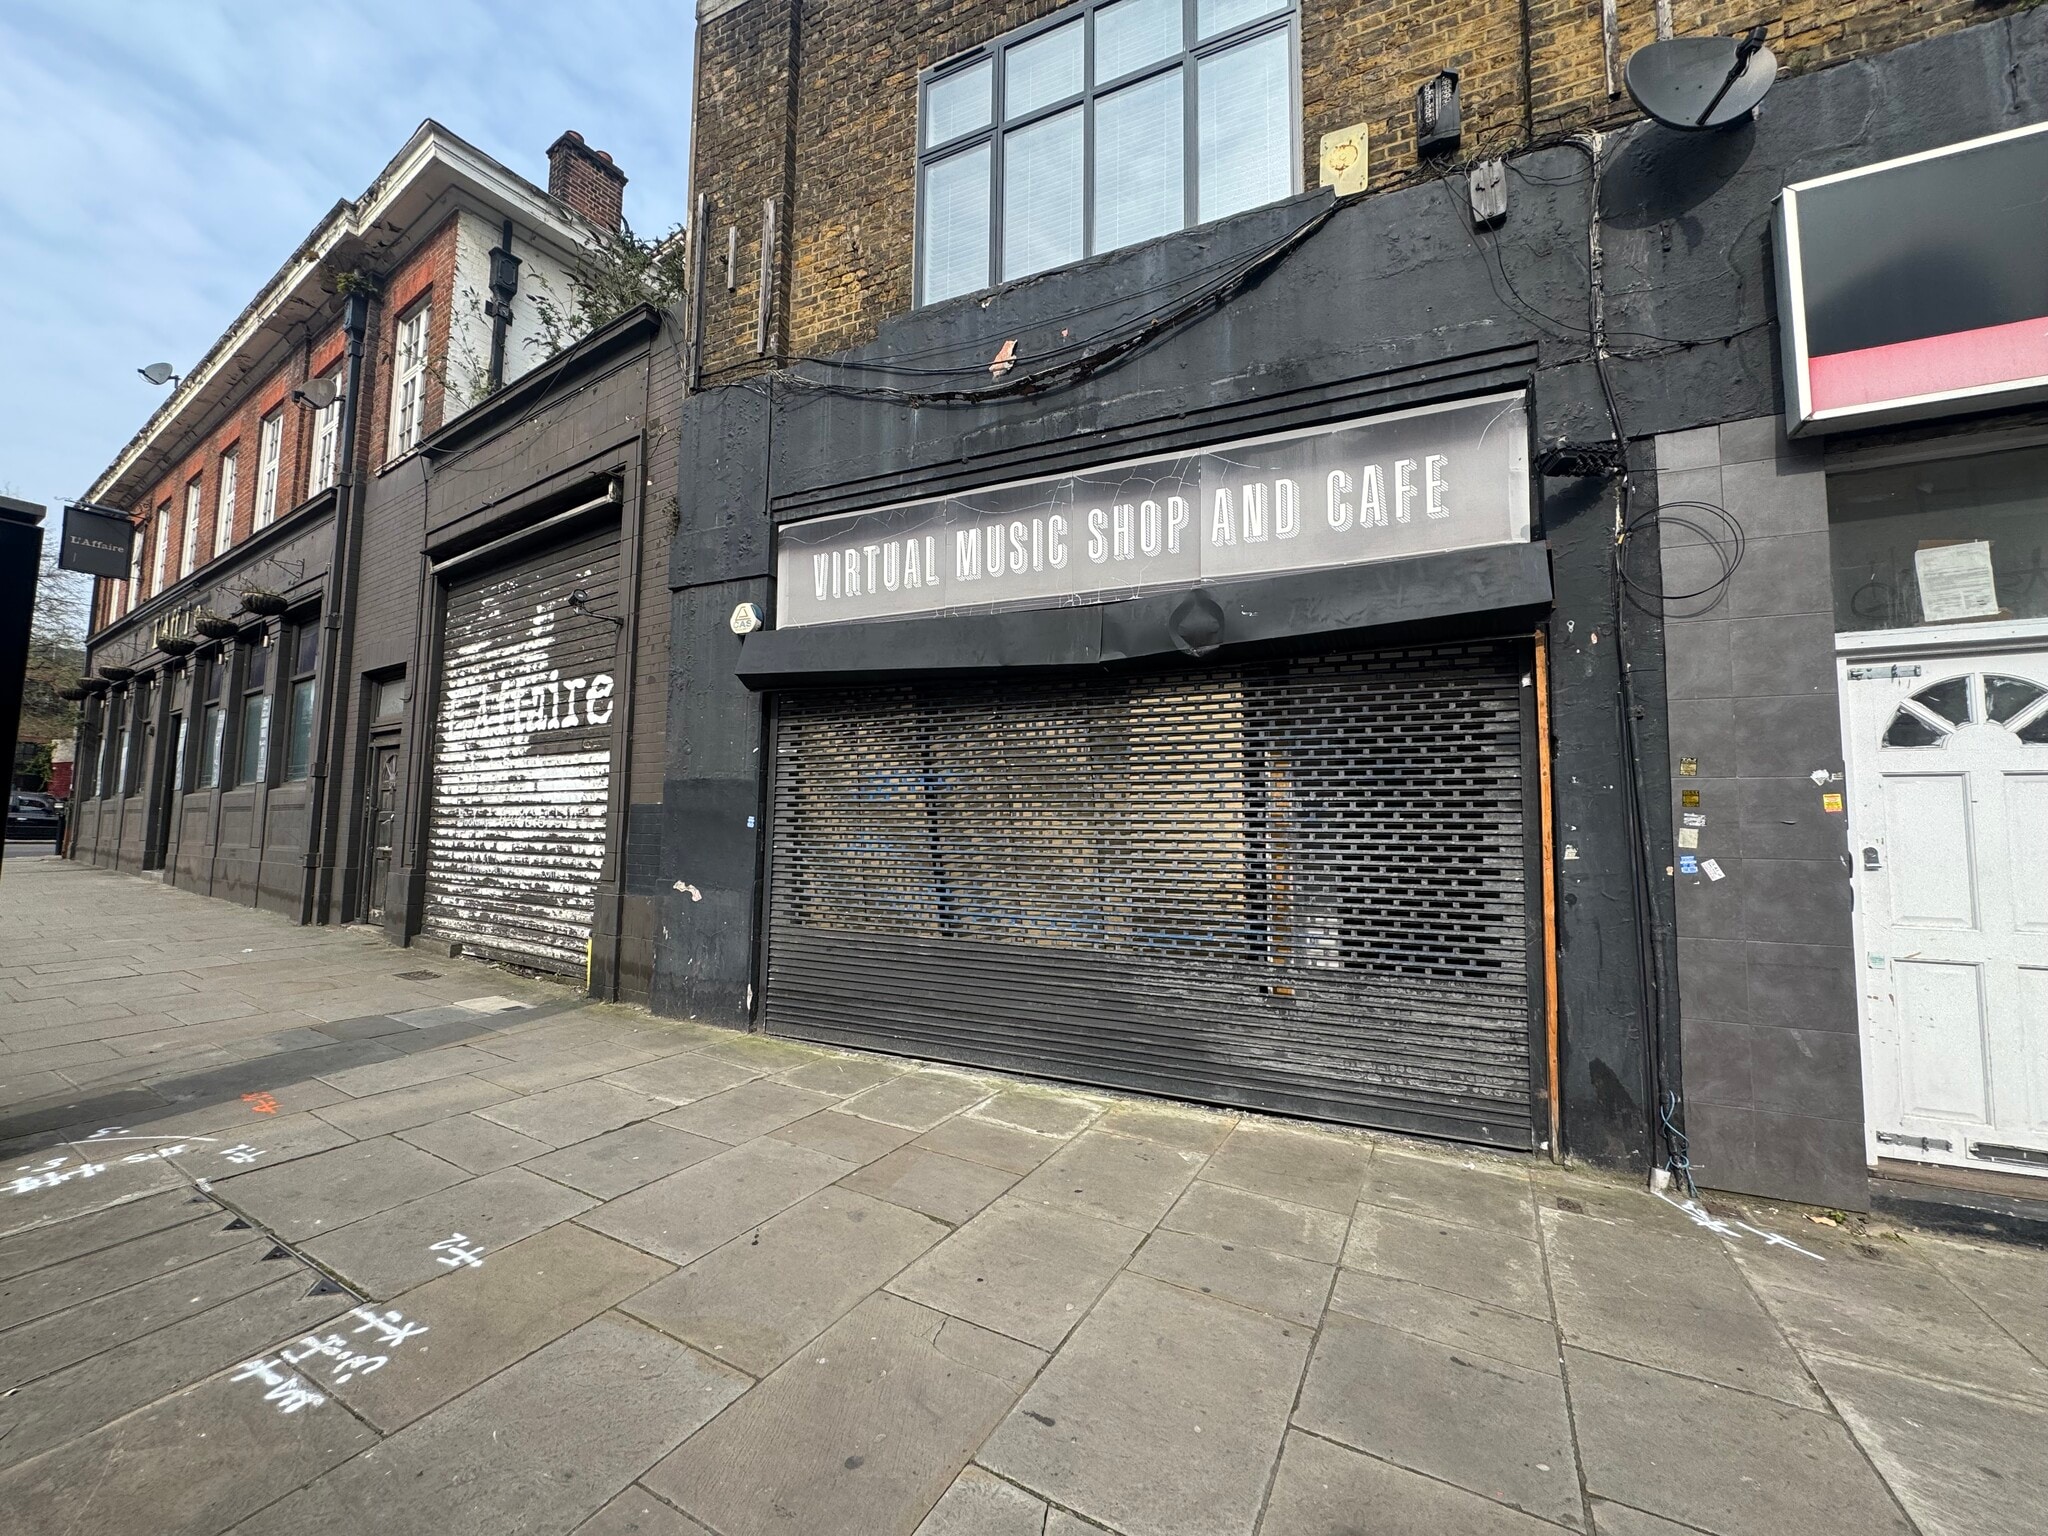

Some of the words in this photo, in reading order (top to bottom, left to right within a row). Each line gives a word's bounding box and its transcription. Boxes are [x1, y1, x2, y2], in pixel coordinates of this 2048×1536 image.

[70, 535, 125, 553] L'Affaire
[813, 535, 940, 601] VIRTUAL
[956, 514, 1068, 582] MUSIC
[1087, 496, 1190, 565] SHOP
[1211, 478, 1301, 547] AND
[1326, 453, 1450, 533] CAFE
